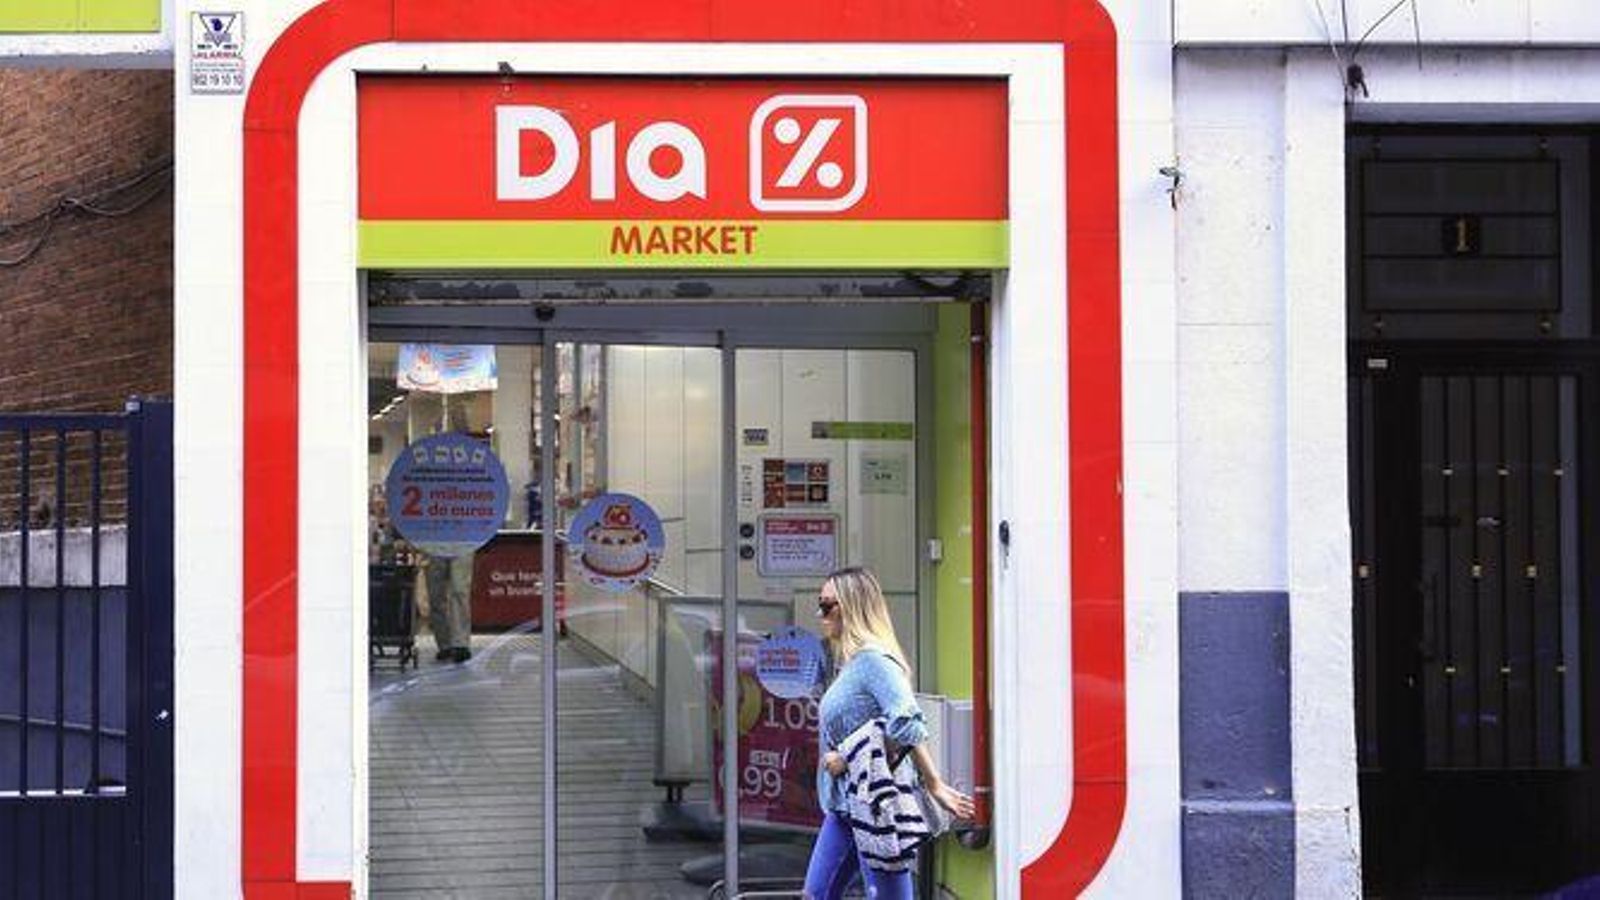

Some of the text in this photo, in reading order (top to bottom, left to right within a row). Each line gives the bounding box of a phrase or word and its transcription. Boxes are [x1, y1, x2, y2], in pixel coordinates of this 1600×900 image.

[610, 225, 758, 255] MARKET
[1456, 221, 1470, 252] 1
[401, 486, 423, 517] 2
[429, 486, 497, 501] millones
[428, 502, 497, 517] de euros
